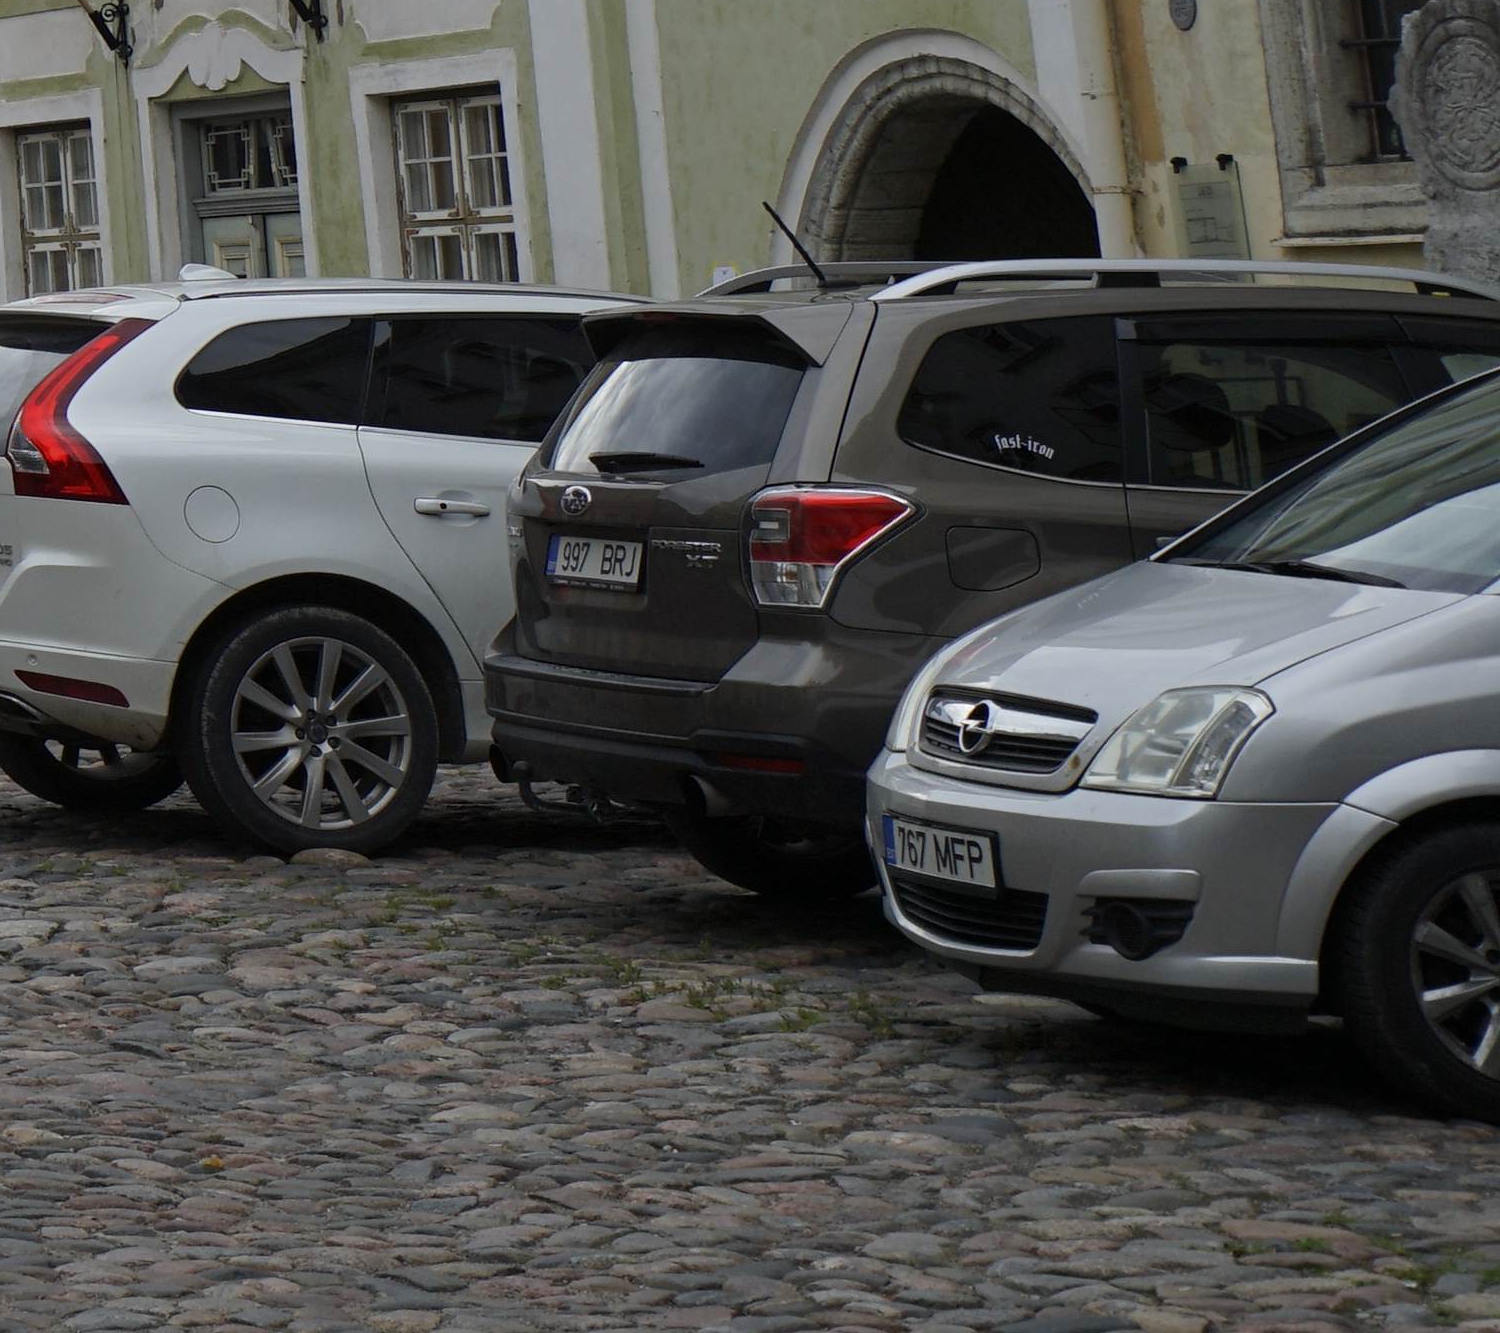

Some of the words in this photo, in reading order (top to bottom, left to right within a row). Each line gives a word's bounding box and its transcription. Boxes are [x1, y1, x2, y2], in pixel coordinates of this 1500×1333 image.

[994, 434, 1055, 460] fast-iron
[562, 541, 590, 573] 997
[600, 544, 637, 577] BRJ
[897, 826, 926, 869] 767
[933, 833, 983, 878] MFP
